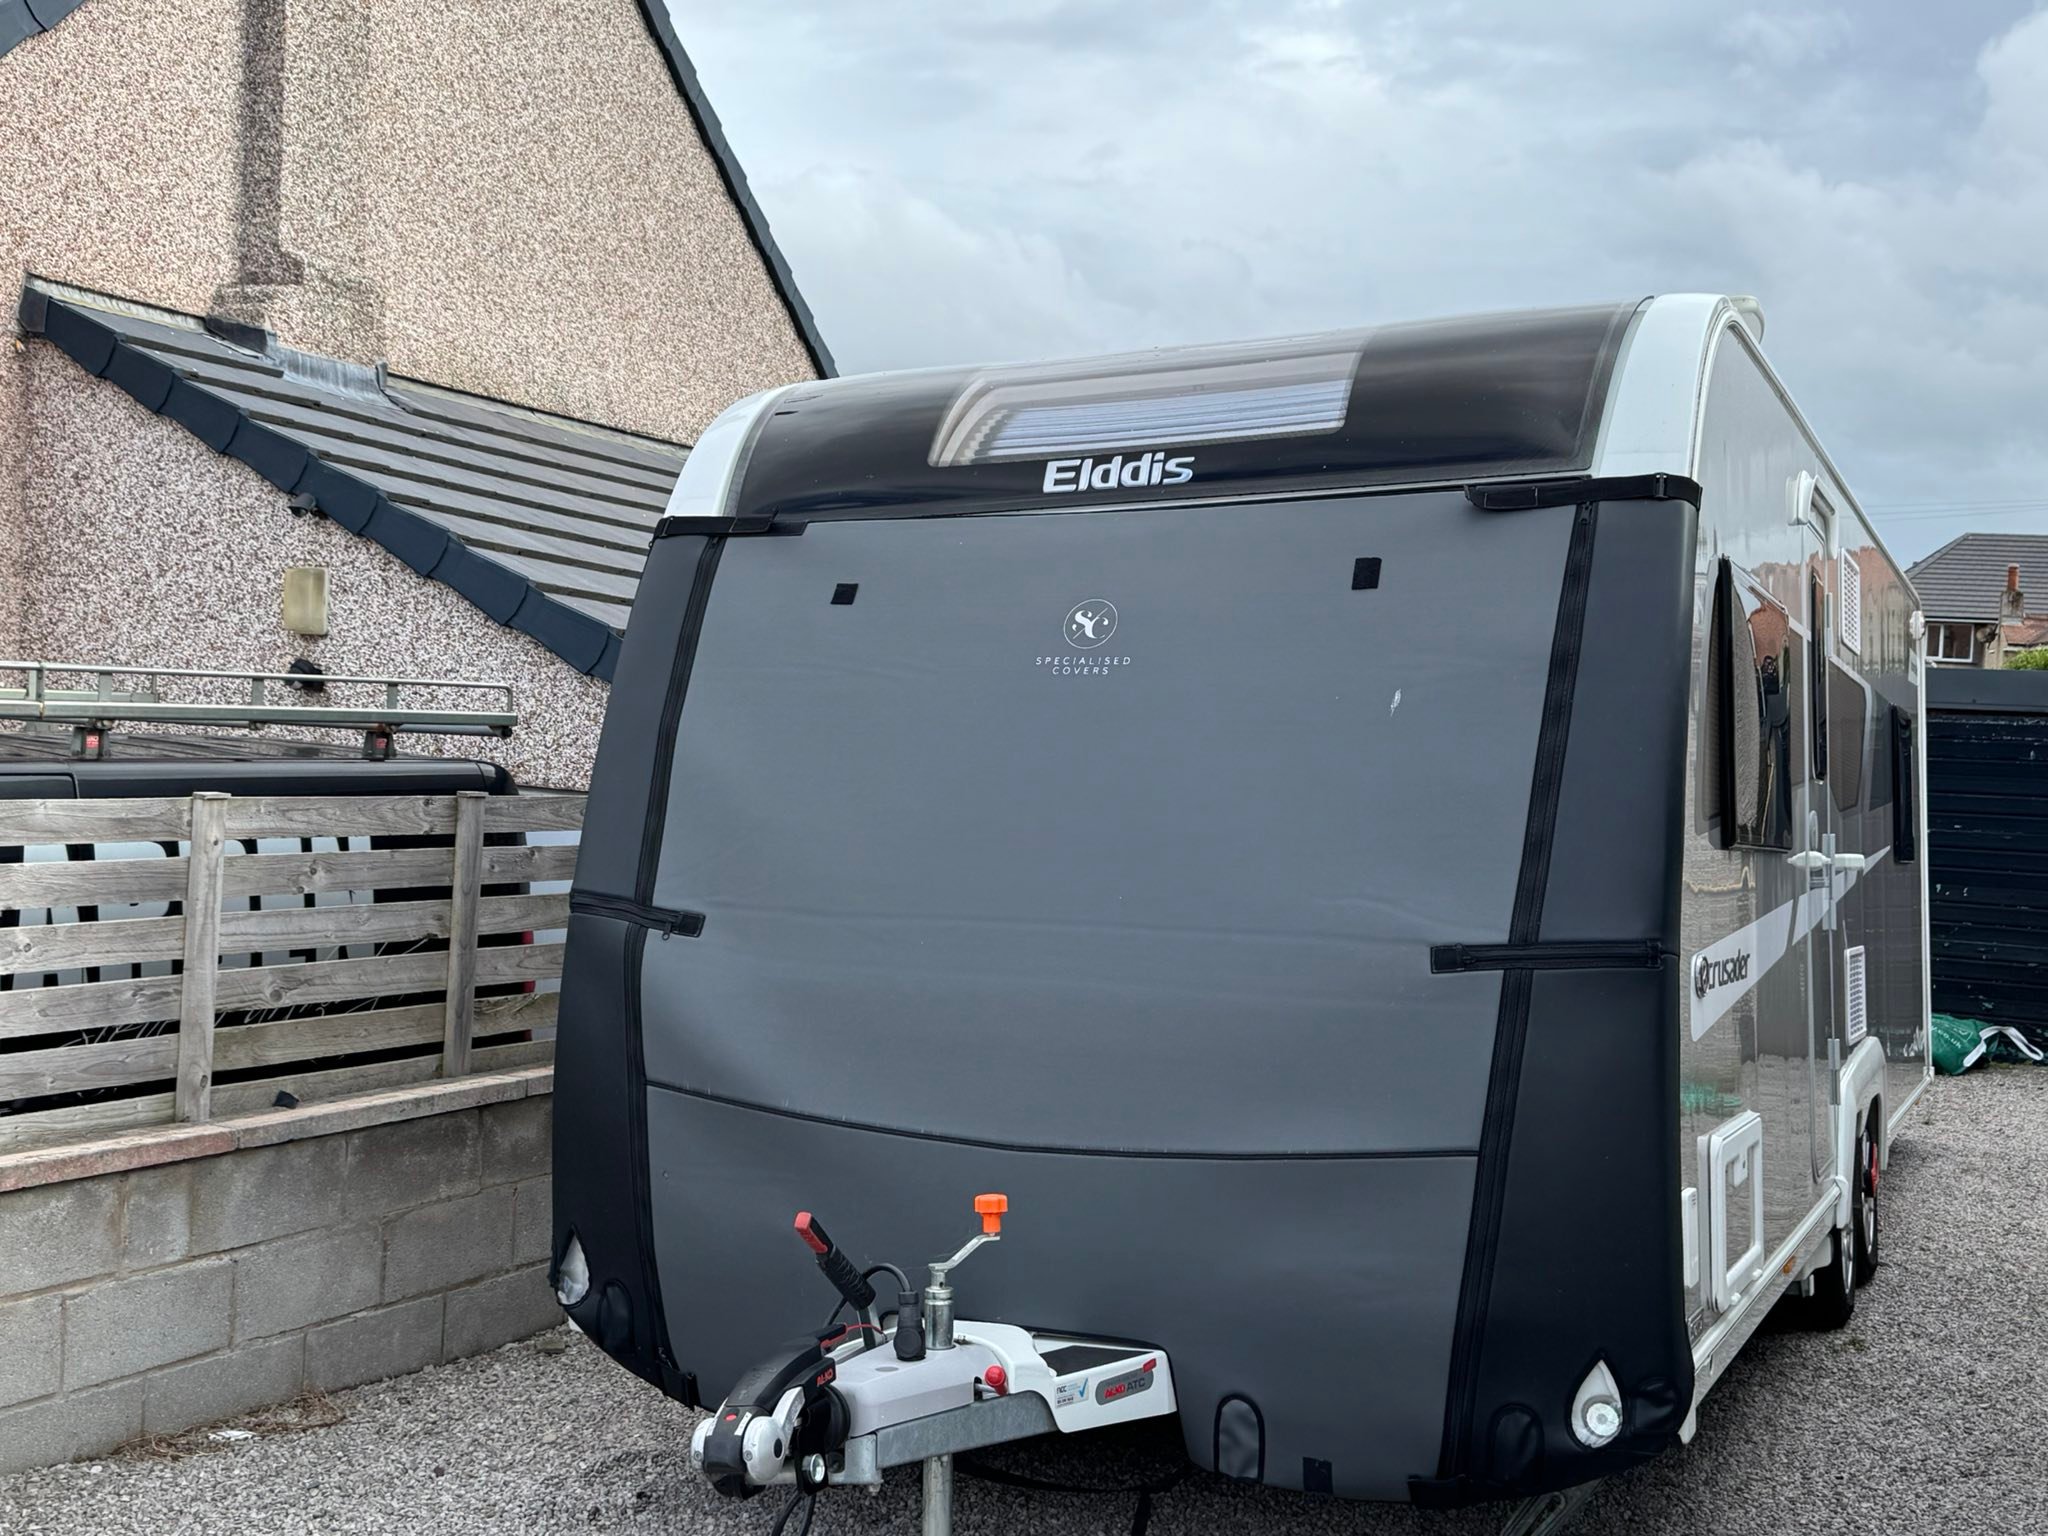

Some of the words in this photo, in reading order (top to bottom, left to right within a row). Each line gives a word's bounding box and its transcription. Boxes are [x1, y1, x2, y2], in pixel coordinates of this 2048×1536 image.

[1043, 451, 1195, 494] Elddis
[1035, 656, 1131, 666] SPECIALISED
[1052, 666, 1109, 675] COVERS
[1127, 1377, 1146, 1392] ATC
